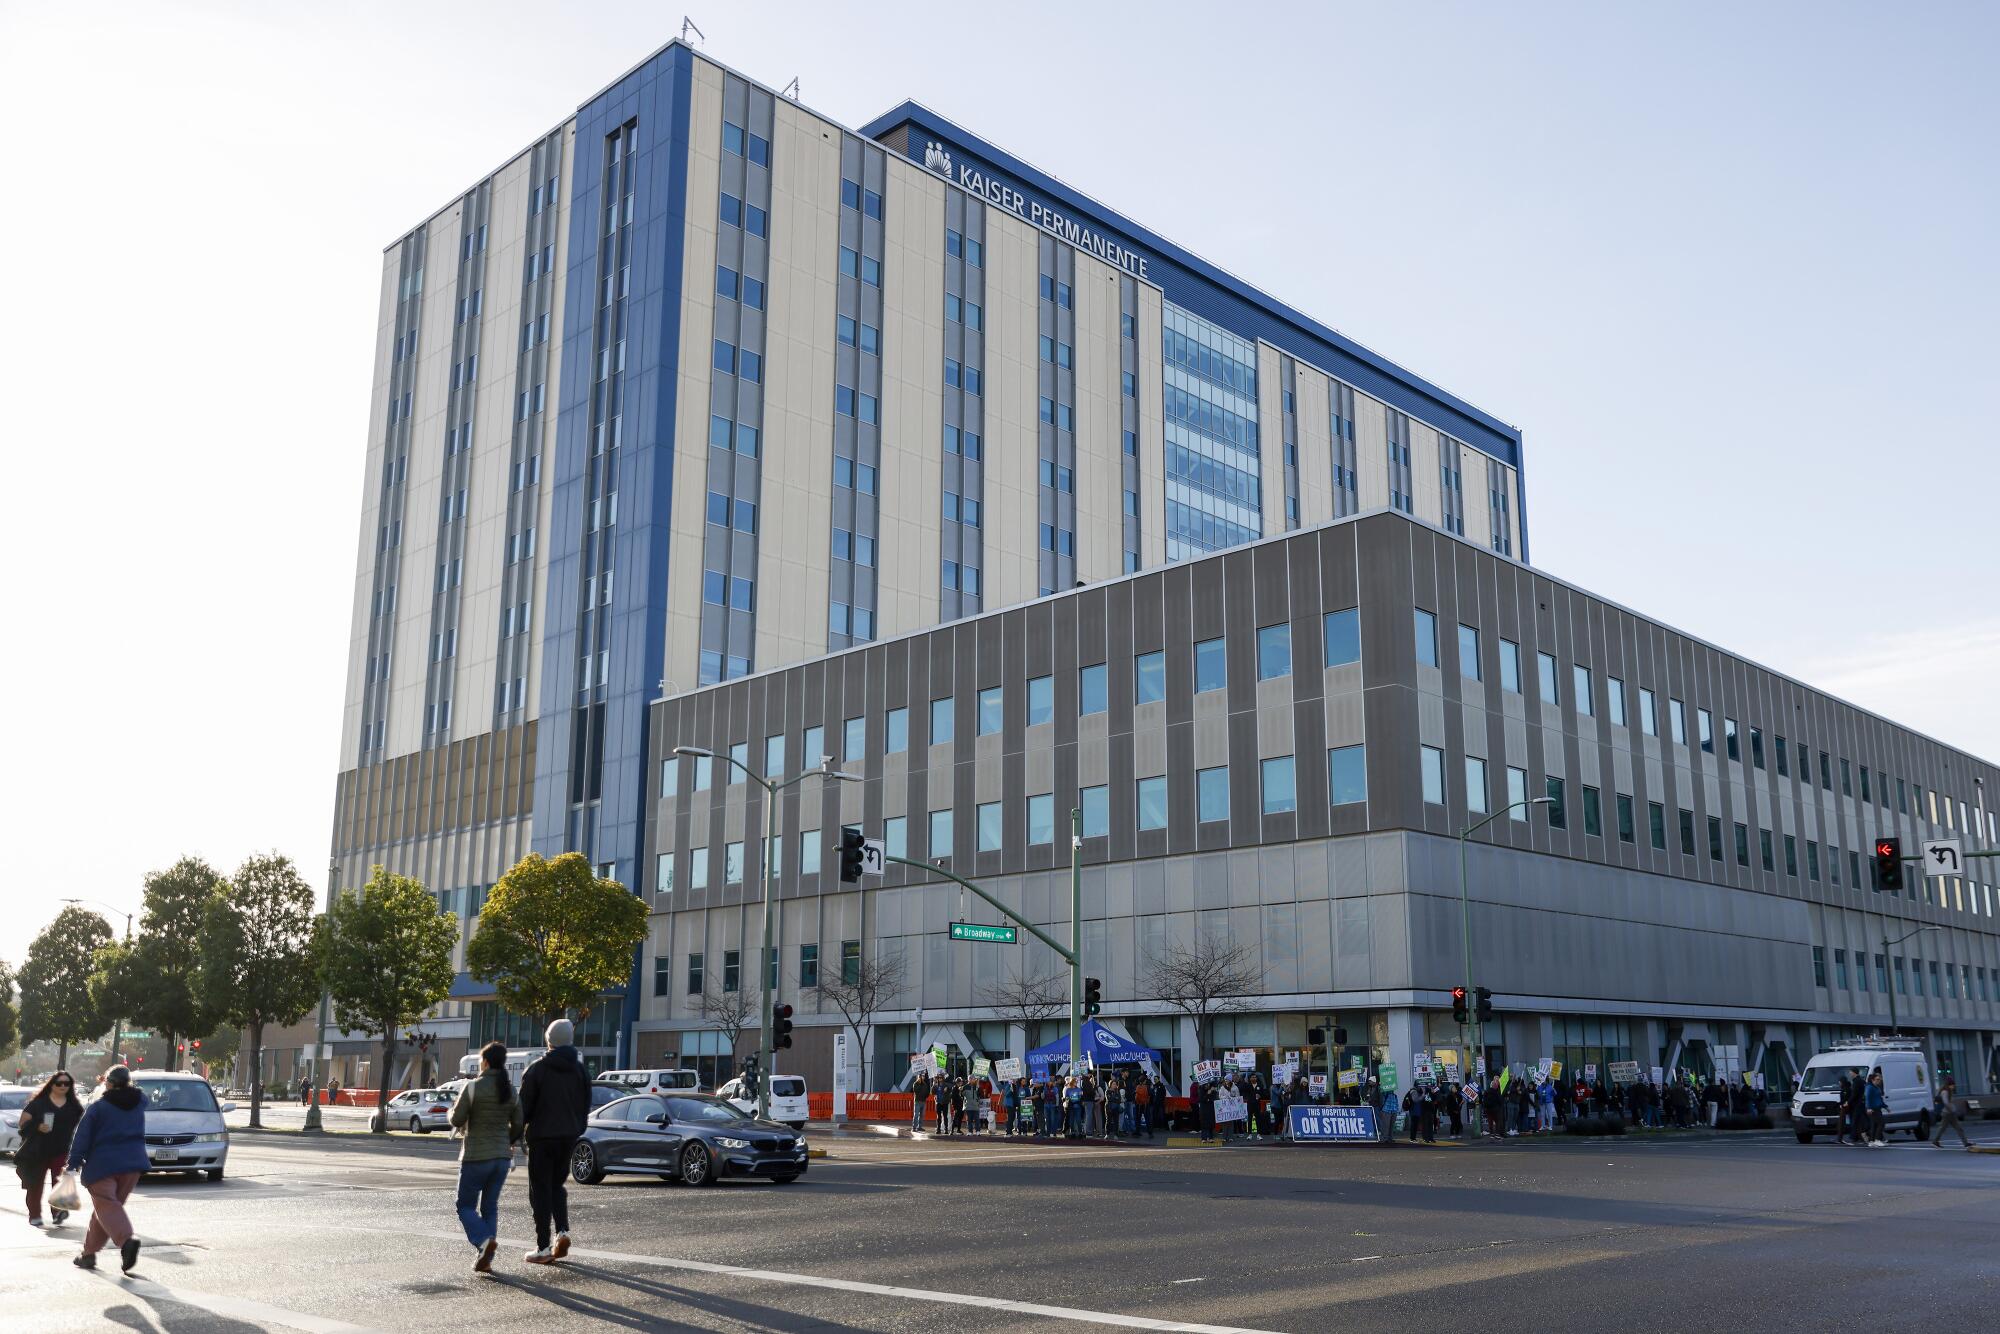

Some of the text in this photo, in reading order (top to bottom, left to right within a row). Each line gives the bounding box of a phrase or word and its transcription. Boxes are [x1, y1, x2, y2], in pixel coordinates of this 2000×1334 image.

[960, 164, 1148, 278] KAISER PERMANENTE
[964, 927, 996, 940] Broadway
[1196, 1062, 1208, 1071] ULP
[1197, 1071, 1213, 1081] STRIKE
[1313, 1076, 1324, 1084] ULP
[1464, 1086, 1477, 1099] NOW
[1307, 1108, 1356, 1117] THIS HOSPITAL IS
[1301, 1117, 1366, 1135] ON STRIKE
